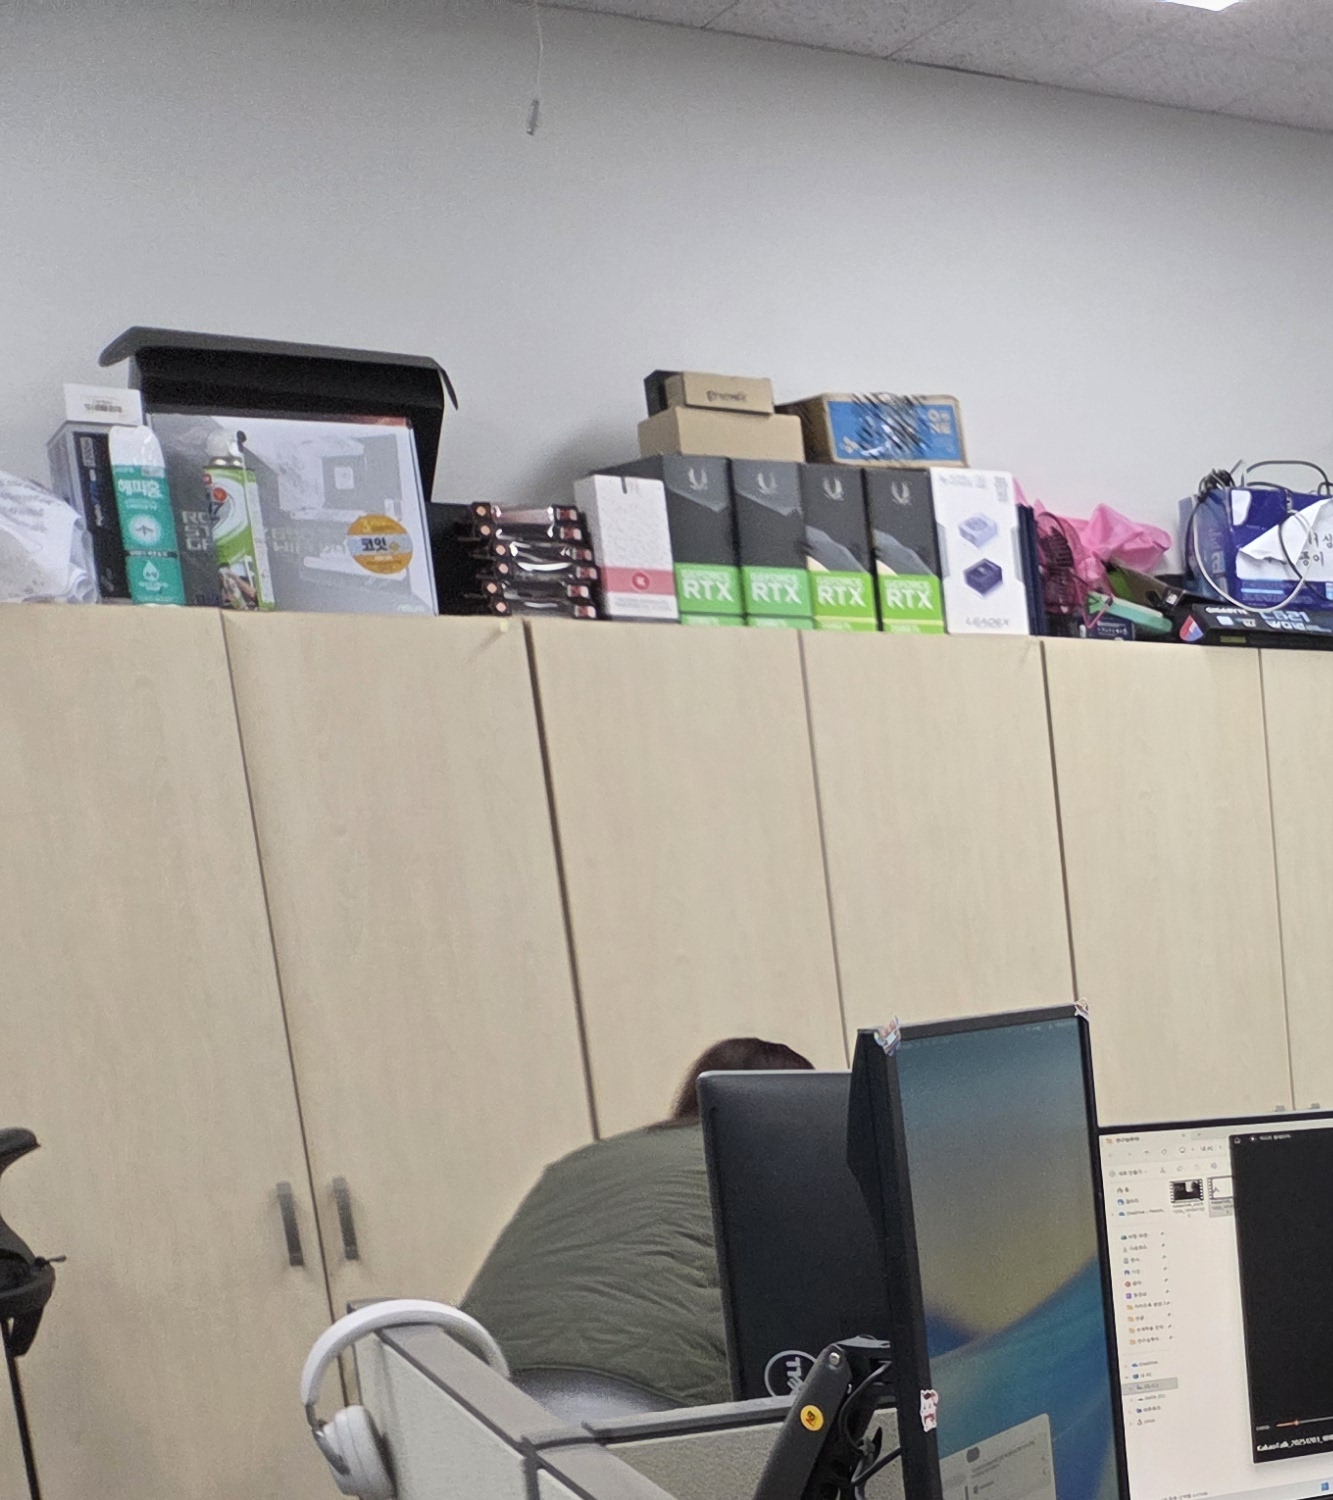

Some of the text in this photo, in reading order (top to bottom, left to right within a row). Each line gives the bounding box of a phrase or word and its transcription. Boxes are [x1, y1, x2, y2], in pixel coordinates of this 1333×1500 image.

[682, 579, 734, 603] RTX
[752, 582, 802, 605] RTX
[817, 585, 867, 608] RTX
[886, 589, 935, 611] RTX
